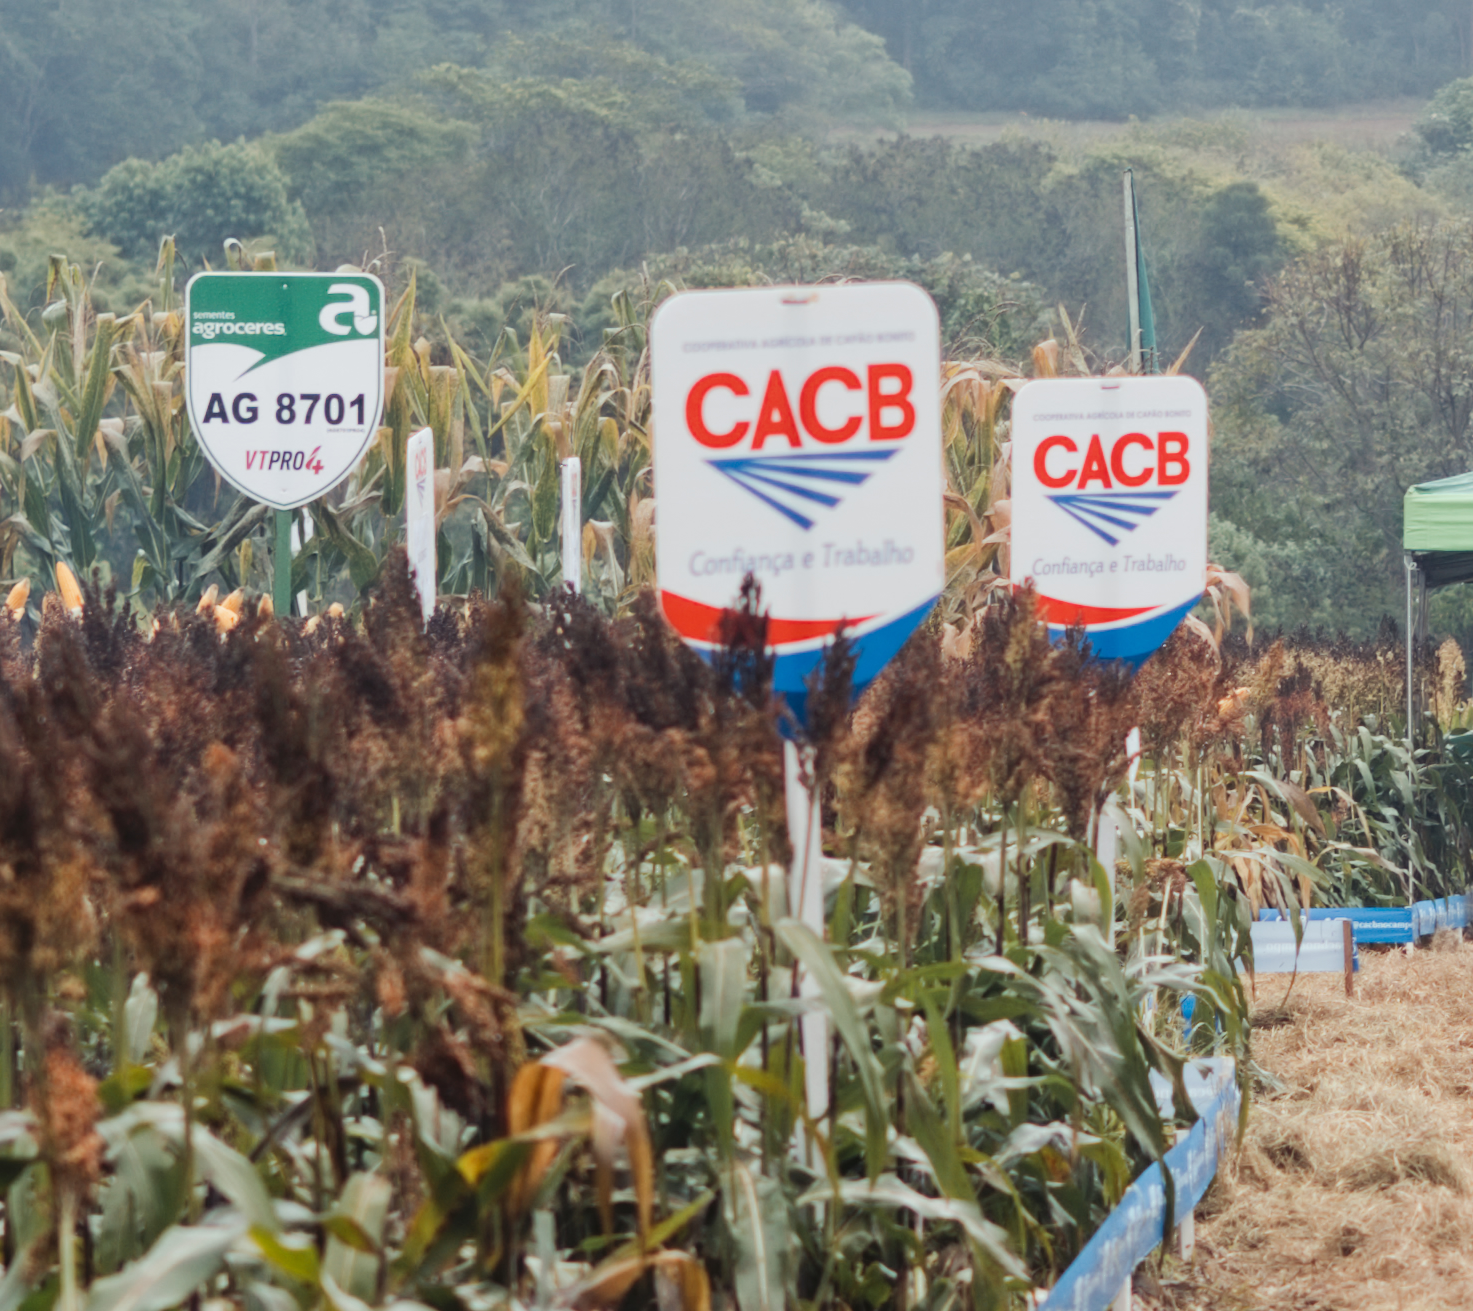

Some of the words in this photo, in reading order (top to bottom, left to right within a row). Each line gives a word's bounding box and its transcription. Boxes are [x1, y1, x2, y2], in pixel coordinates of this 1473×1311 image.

[193, 311, 235, 319] sementes
[193, 322, 285, 338] agroceres
[203, 393, 258, 424] AG
[275, 393, 365, 425] 8701
[685, 363, 916, 449] CACB
[1033, 413, 1084, 421] COOPERATIVA
[1165, 410, 1191, 418] BONITO
[1034, 432, 1190, 489] CACB
[689, 549, 793, 577] Confiança
[802, 553, 814, 568] e
[823, 540, 914, 567] Trabalho
[1032, 556, 1104, 577] Confiança
[1109, 560, 1117, 572] e
[1123, 554, 1186, 572] Trabalho
